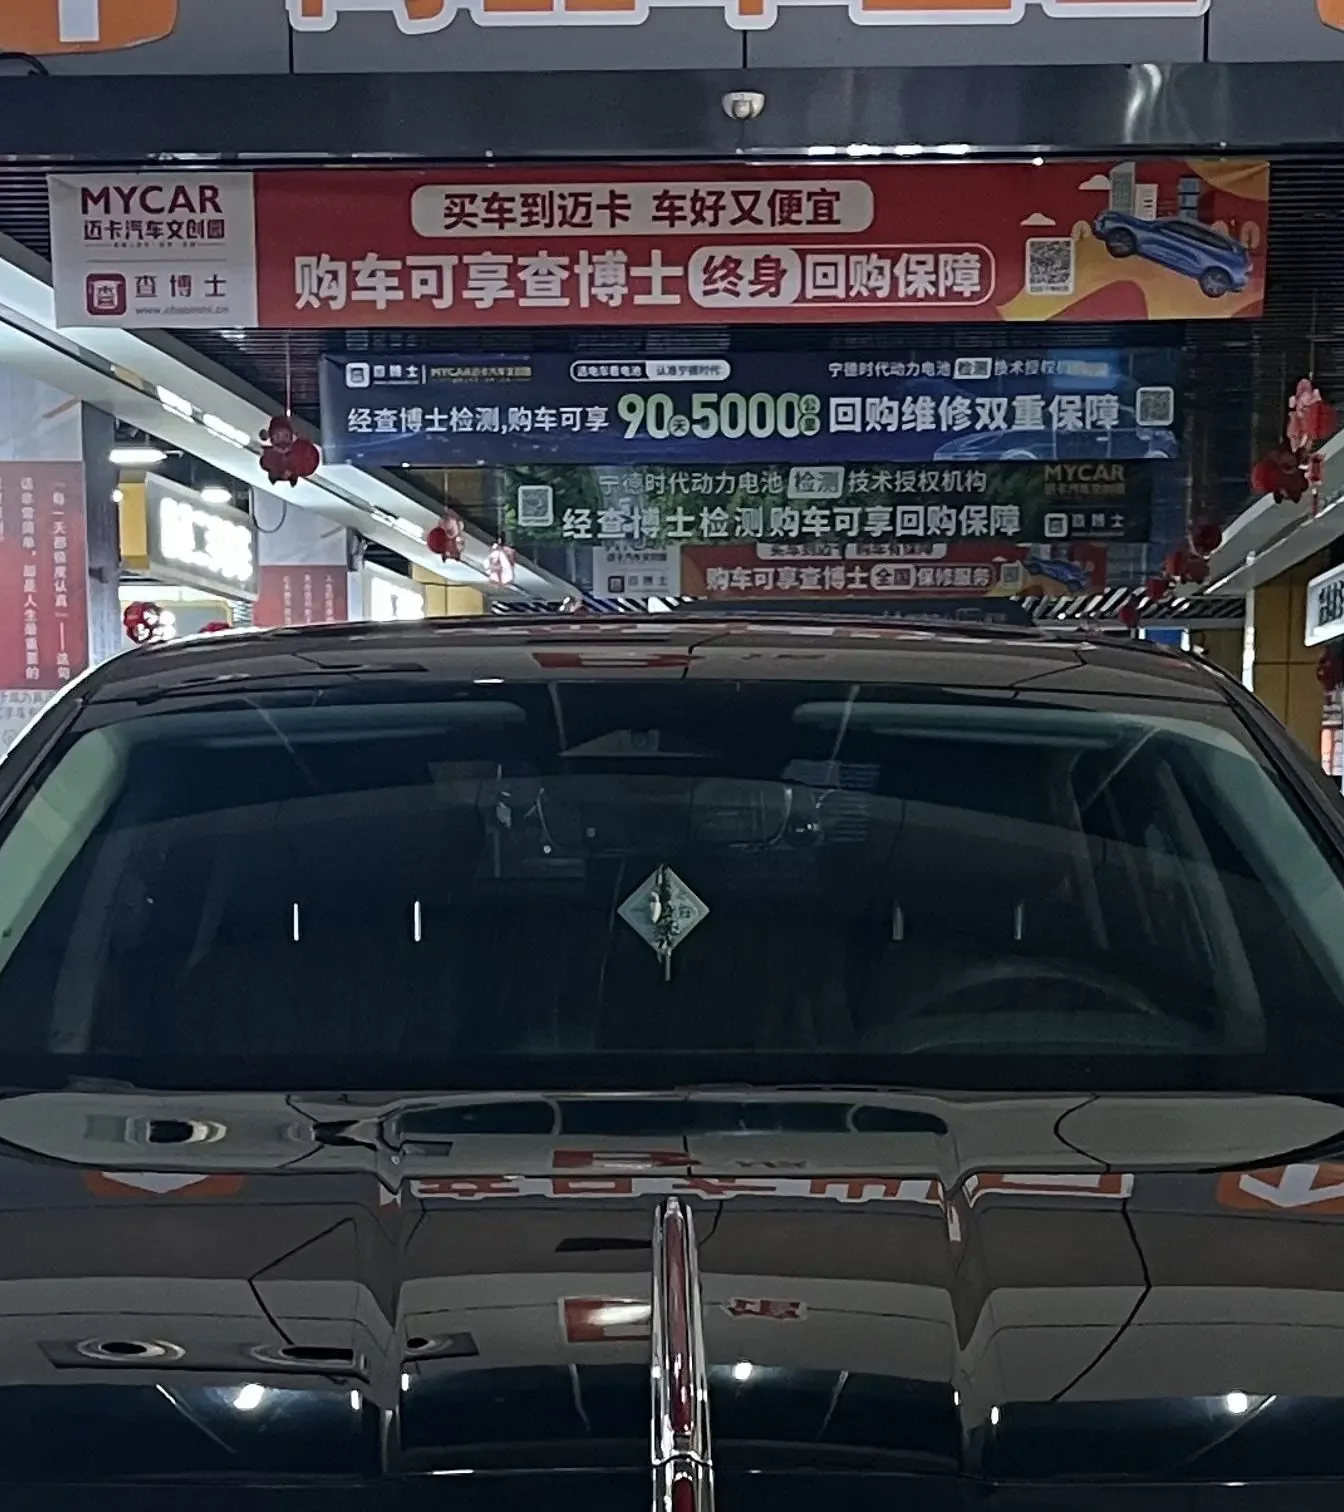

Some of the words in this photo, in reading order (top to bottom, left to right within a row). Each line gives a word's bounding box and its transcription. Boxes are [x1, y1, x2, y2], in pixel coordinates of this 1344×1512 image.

[81, 184, 223, 215] MYCAR
[443, 191, 632, 231] 买车到迈卡
[651, 188, 841, 227] 车好又便宜
[84, 218, 225, 240] 迈卡汽车文创园
[134, 272, 227, 298] 查博士
[294, 249, 684, 310] 购车可享查博士
[701, 254, 787, 298] 终身
[803, 253, 982, 299] 回购保障
[828, 361, 952, 378] 宁德时代动力电池
[347, 406, 609, 434] 经查博士检测,购车可享
[829, 394, 1119, 433] 回购维修双重保障
[599, 471, 783, 495] 宁德时代动力电池
[848, 470, 987, 494] 技术授权机构
[1044, 464, 1125, 482] MYCAR
[706, 565, 869, 591] 购车可享查博士
